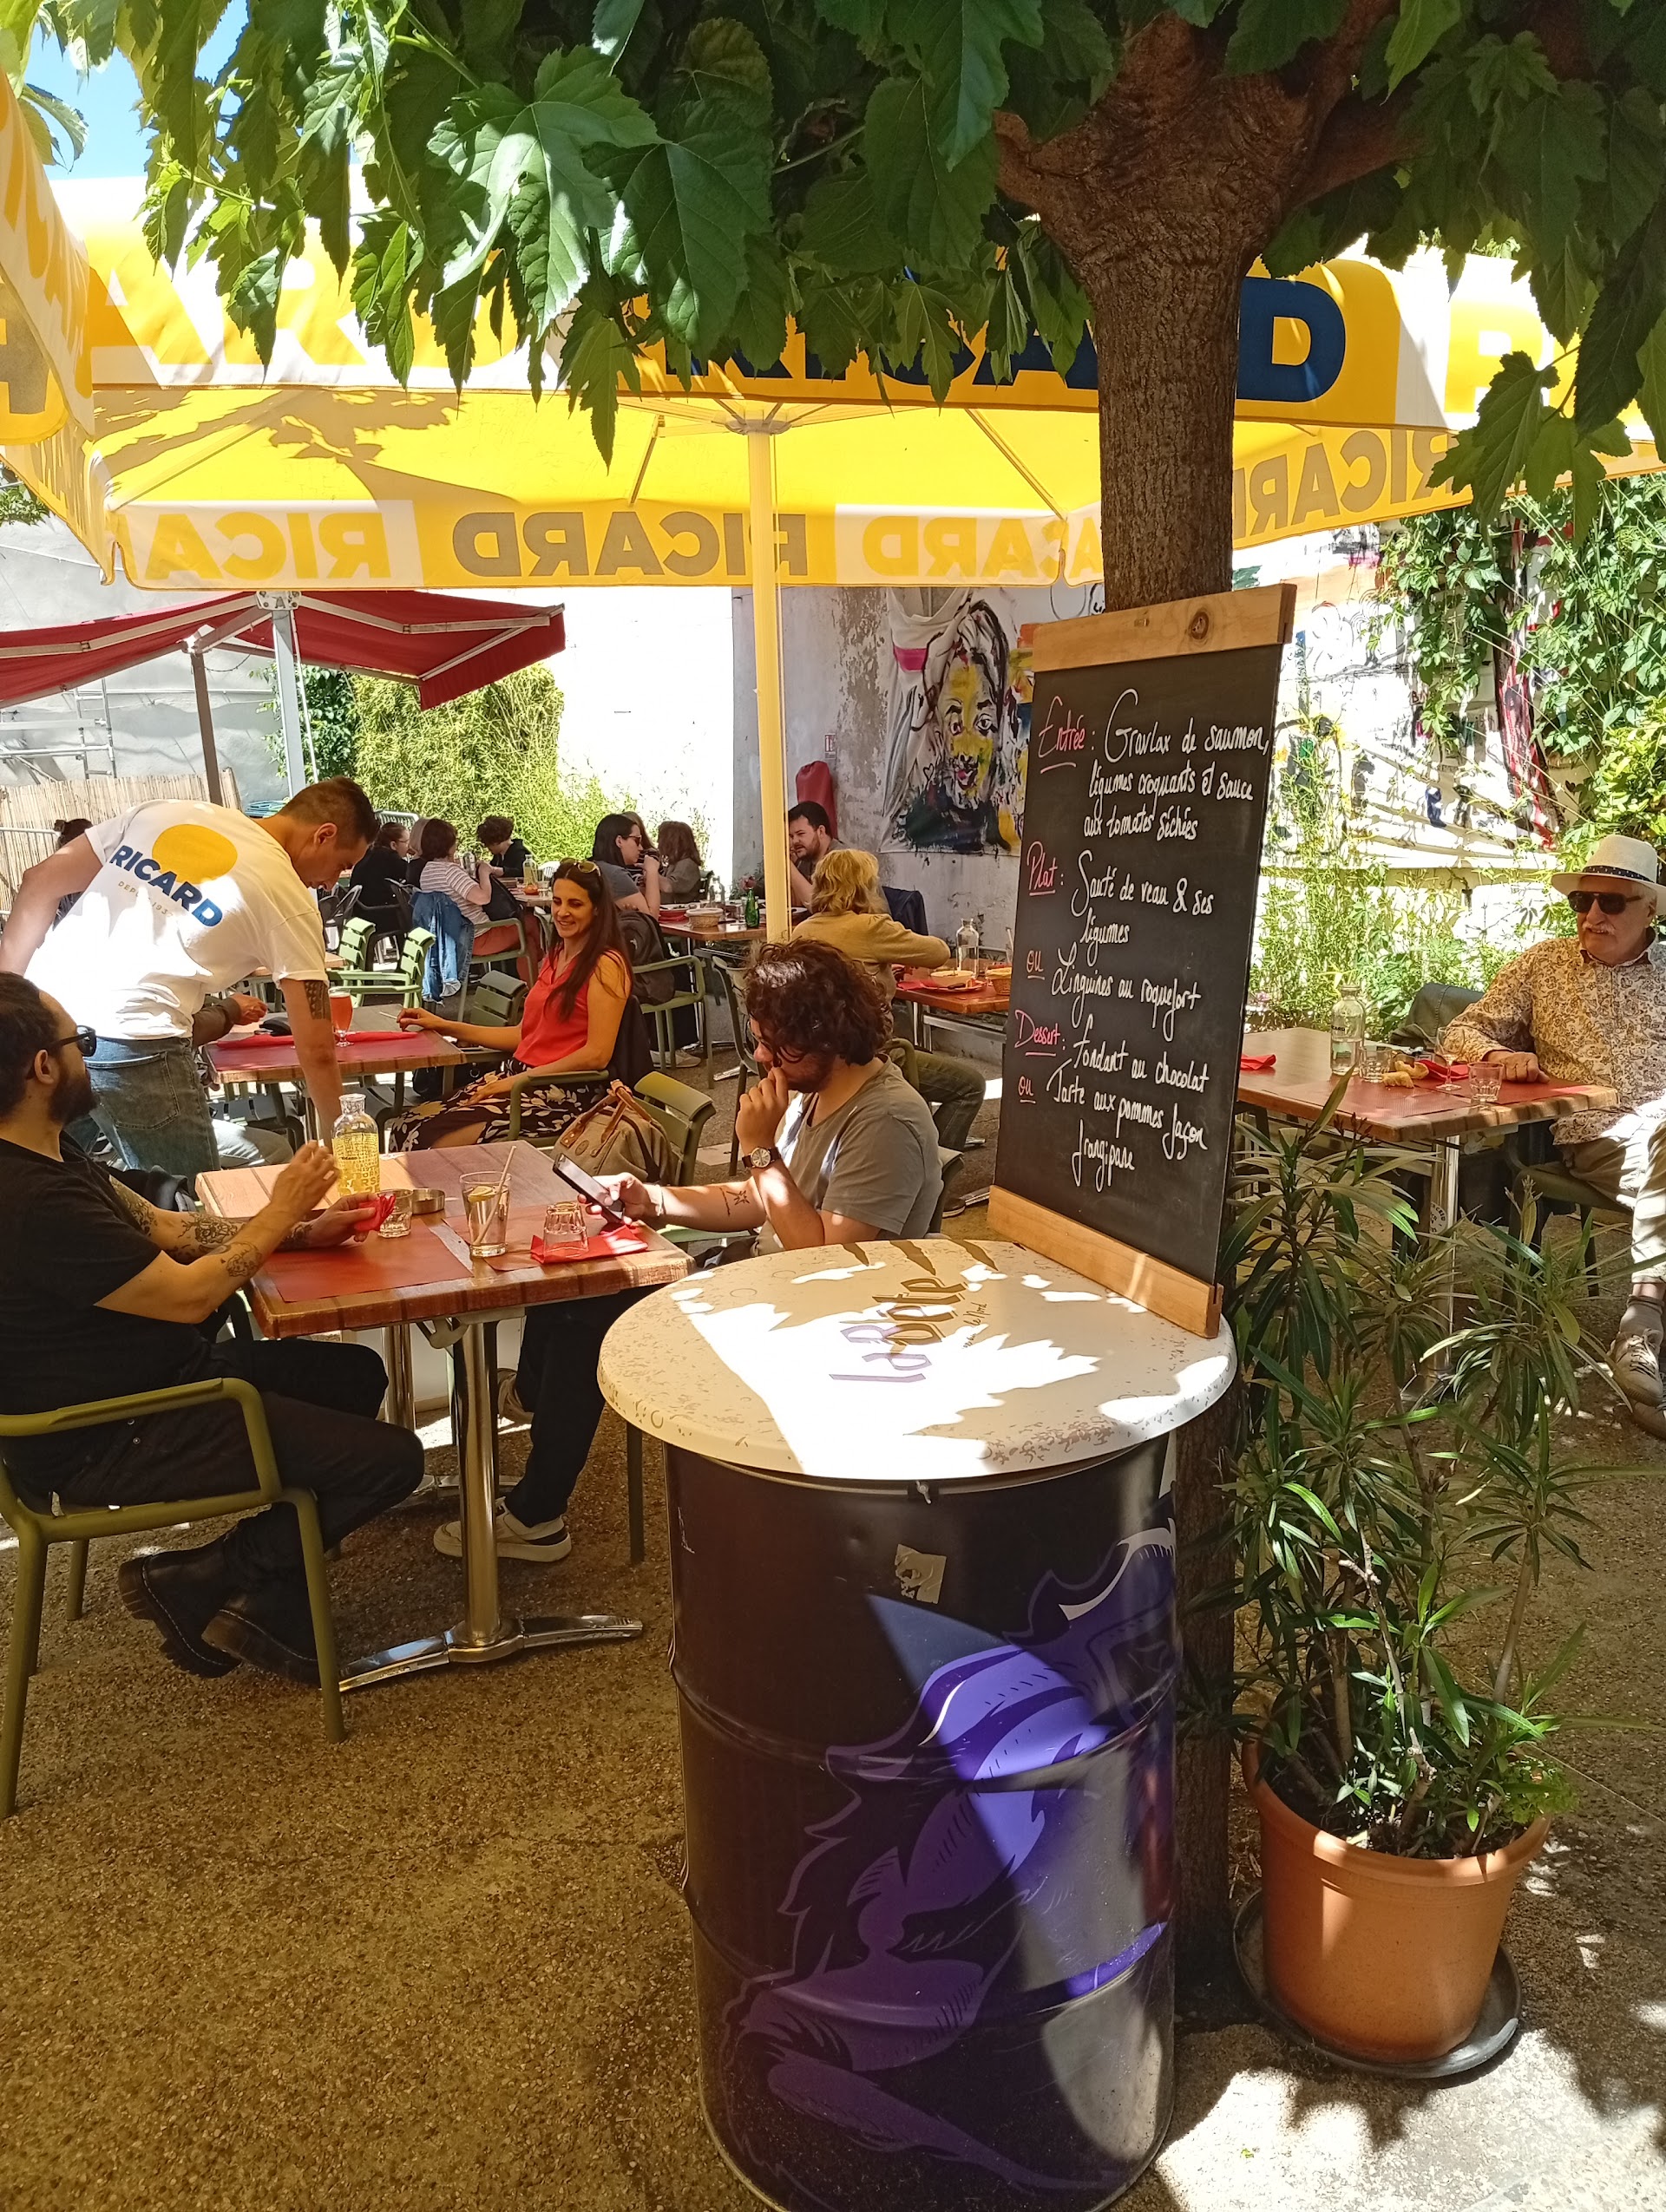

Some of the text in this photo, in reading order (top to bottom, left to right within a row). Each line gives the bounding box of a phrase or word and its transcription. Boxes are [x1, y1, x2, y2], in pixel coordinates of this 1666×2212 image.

[1182, 717, 1197, 755] de
[1138, 759, 1196, 817] croquants
[1202, 761, 1215, 796] et
[1084, 816, 1102, 837] aux
[1106, 805, 1154, 839] tomates
[109, 844, 224, 927] RICARD
[1071, 849, 1118, 917] Sauté
[1119, 874, 1134, 902] de
[1140, 886, 1169, 906] veau
[1172, 877, 1188, 914] &
[1051, 941, 1113, 1029] Linguines
[1118, 978, 1134, 998] au
[1140, 977, 1202, 1042] roquefort
[1046, 1057, 1085, 1104] Tarte
[1093, 1091, 1116, 1111] aux
[1116, 1098, 1163, 1138] pommes
[1131, 1058, 1147, 1080] au
[1155, 1051, 1210, 1093] chocolat
